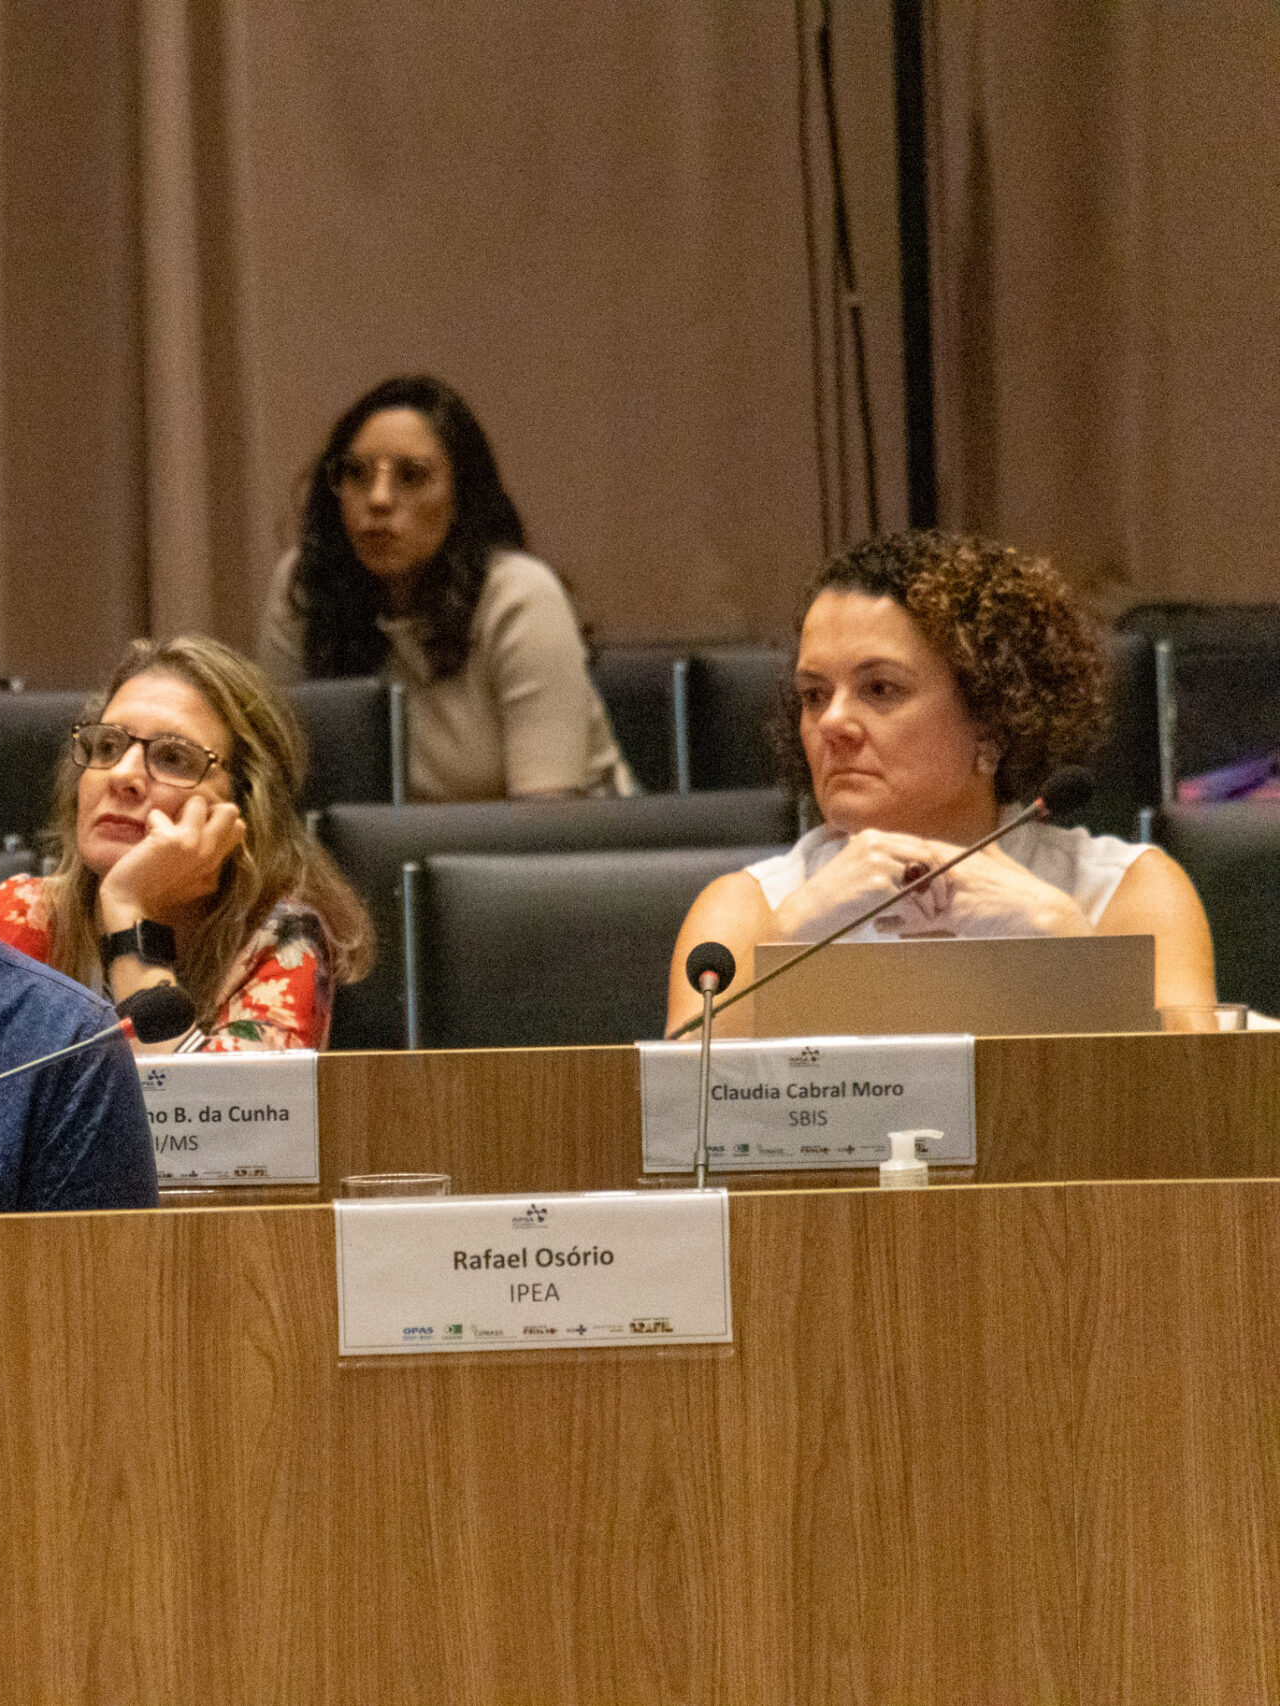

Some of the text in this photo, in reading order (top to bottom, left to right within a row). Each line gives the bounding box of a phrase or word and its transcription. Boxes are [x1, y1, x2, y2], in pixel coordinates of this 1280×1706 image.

[710, 1081, 904, 1101] Claudia Cabral Moro
[146, 1104, 290, 1124] no B. da Cunha
[788, 1109, 828, 1127] SBIS
[155, 1134, 199, 1153] I/MS
[453, 1245, 614, 1270] Rafael Osório
[510, 1282, 560, 1303] IPEA
